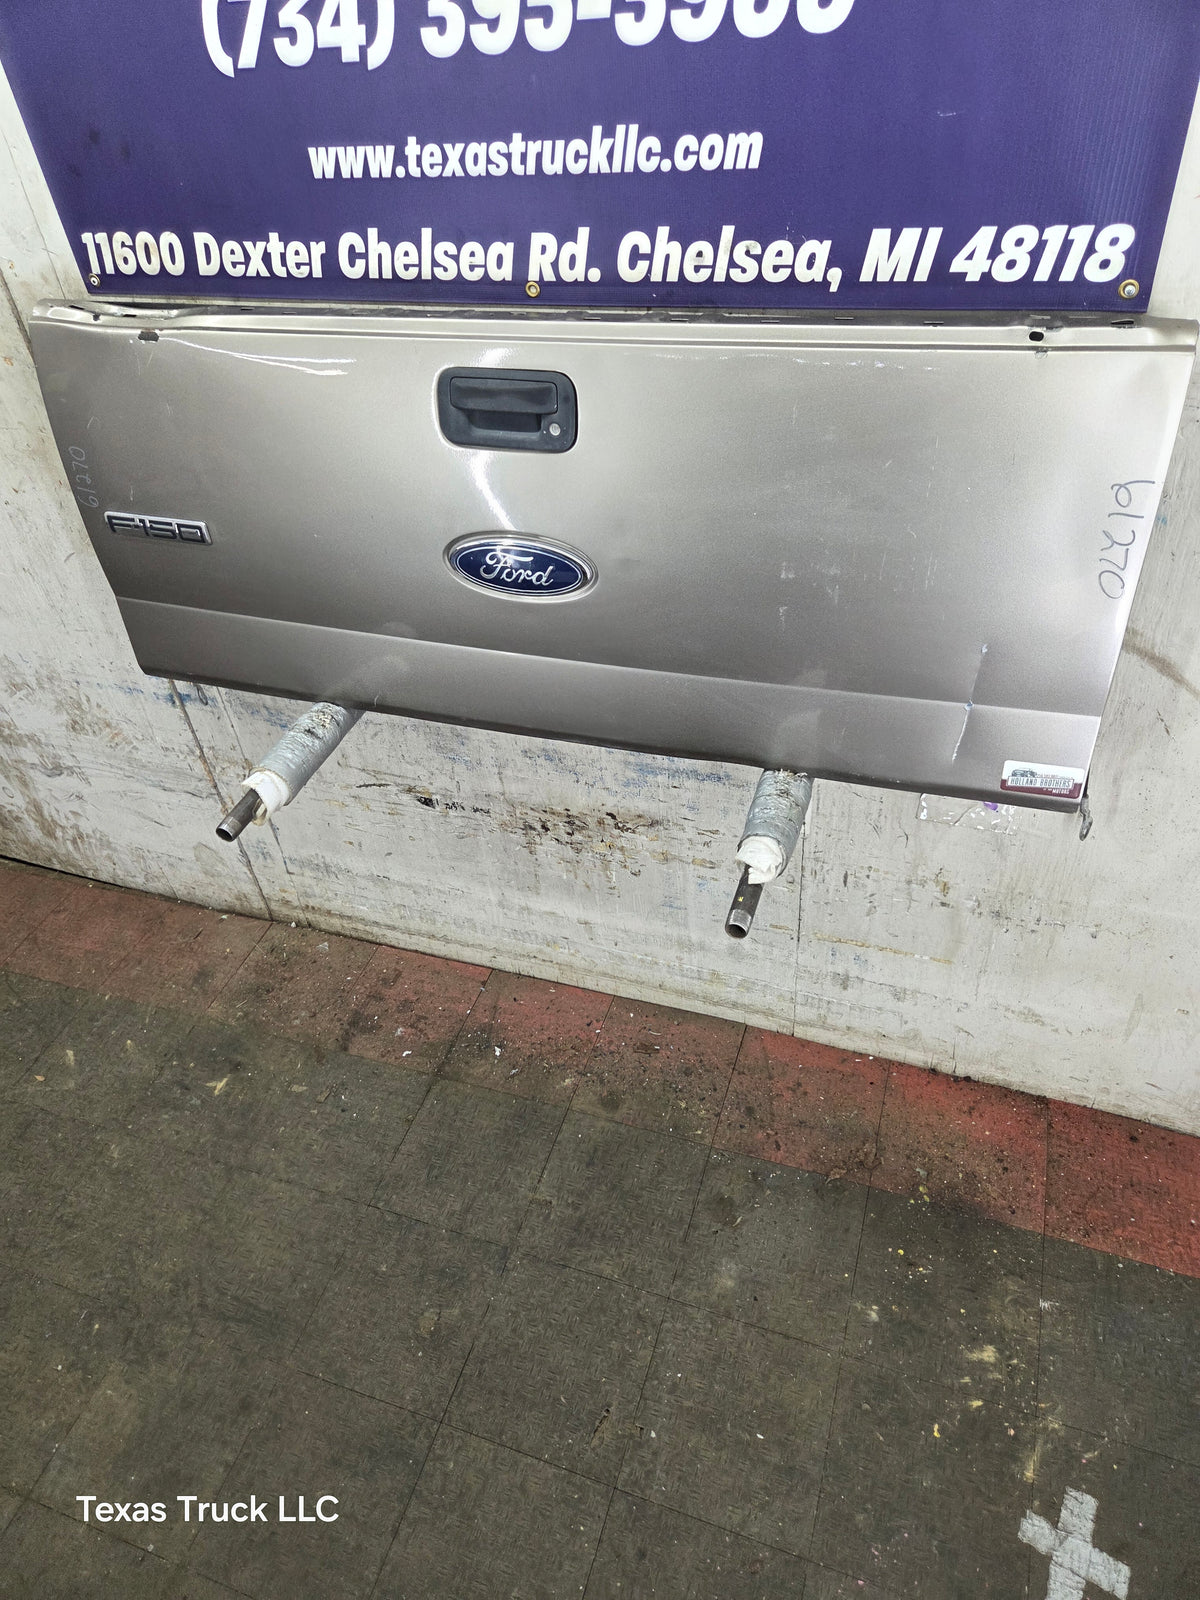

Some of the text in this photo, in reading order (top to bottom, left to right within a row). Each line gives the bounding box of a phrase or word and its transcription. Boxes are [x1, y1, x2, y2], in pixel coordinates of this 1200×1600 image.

[201, 0, 395, 78] (734)
[307, 124, 764, 179] www.texastruckllc.com
[80, 223, 1136, 293] 11600 Dexter Chelsea Rd. Chelsea, MI 48118
[479, 548, 555, 587] Ford
[1098, 479, 1156, 600] 61270
